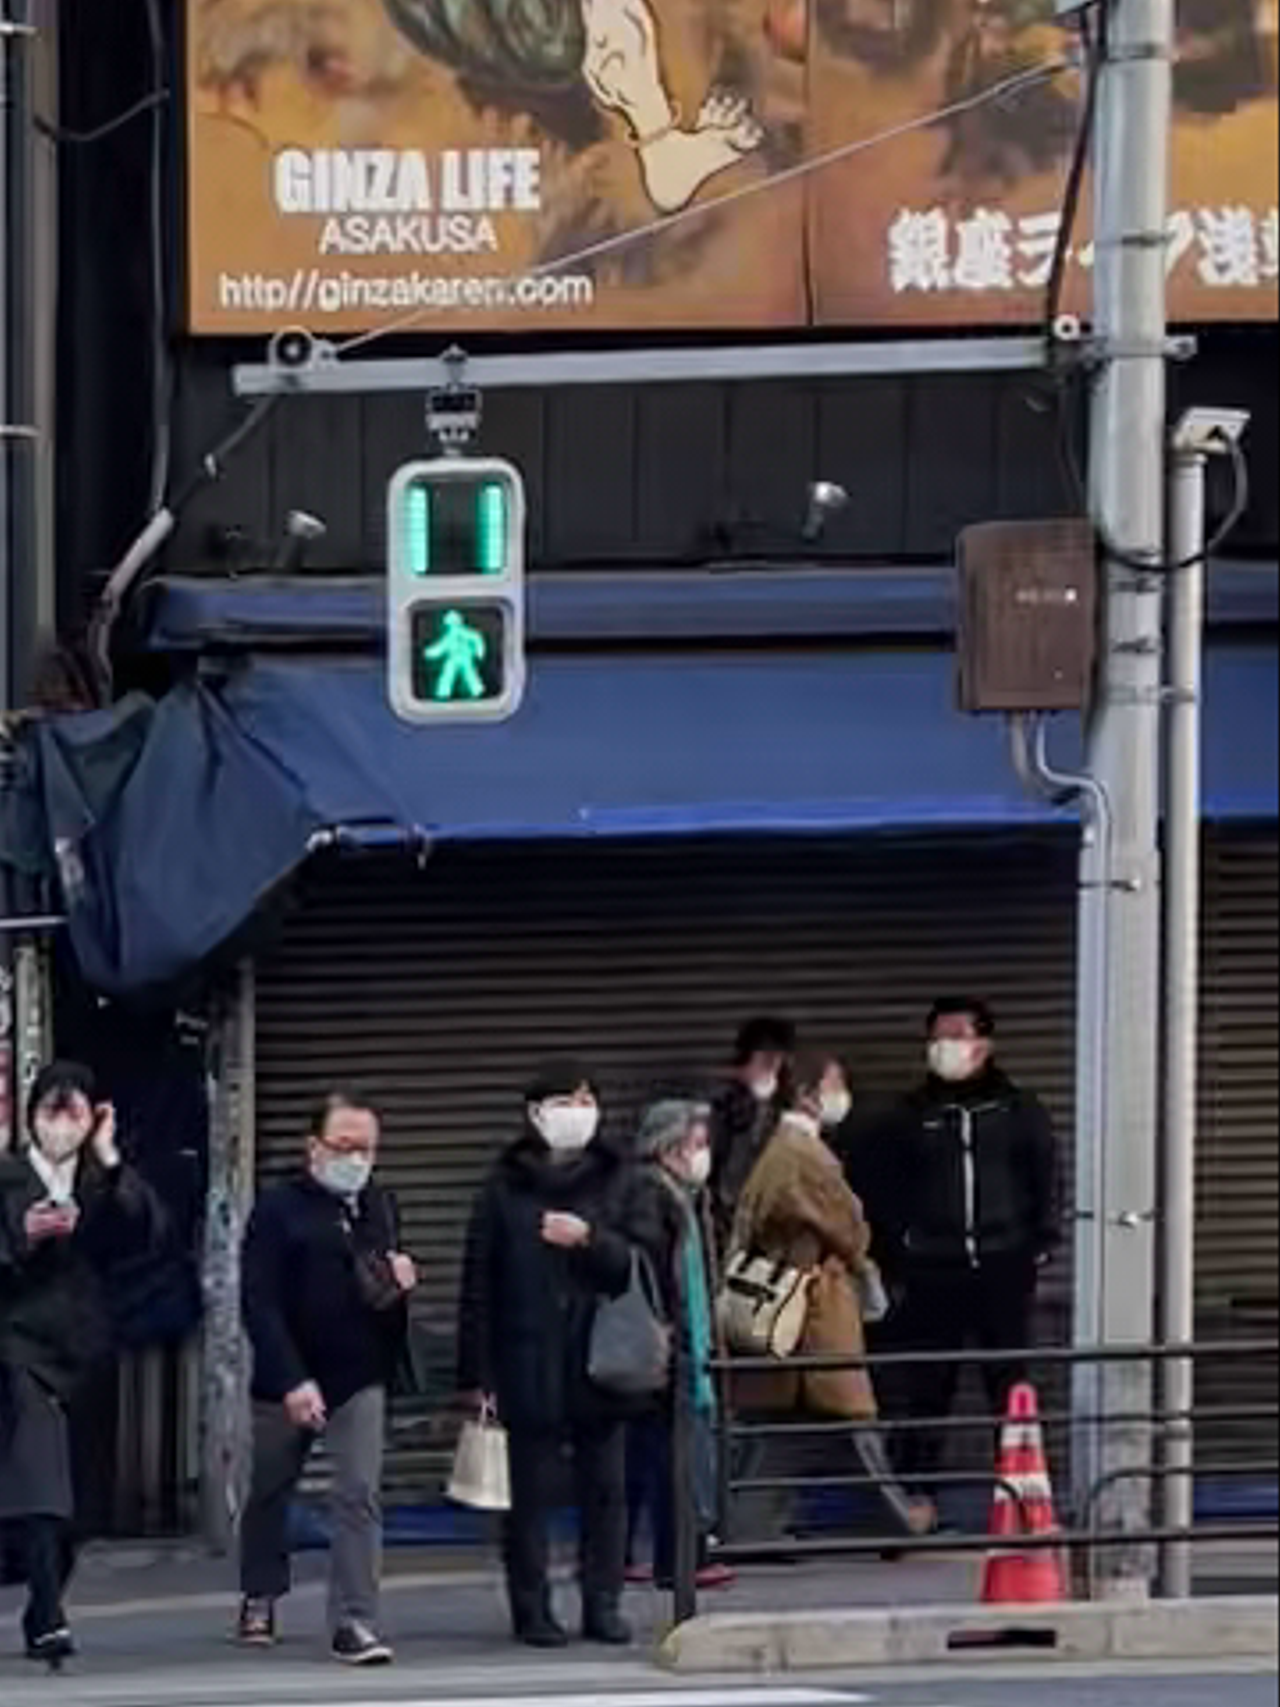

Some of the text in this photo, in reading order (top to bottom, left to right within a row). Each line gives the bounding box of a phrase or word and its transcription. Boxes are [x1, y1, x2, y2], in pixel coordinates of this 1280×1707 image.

[273, 148, 542, 213] GINZA LIFE
[318, 215, 500, 255] ASAKUSA
